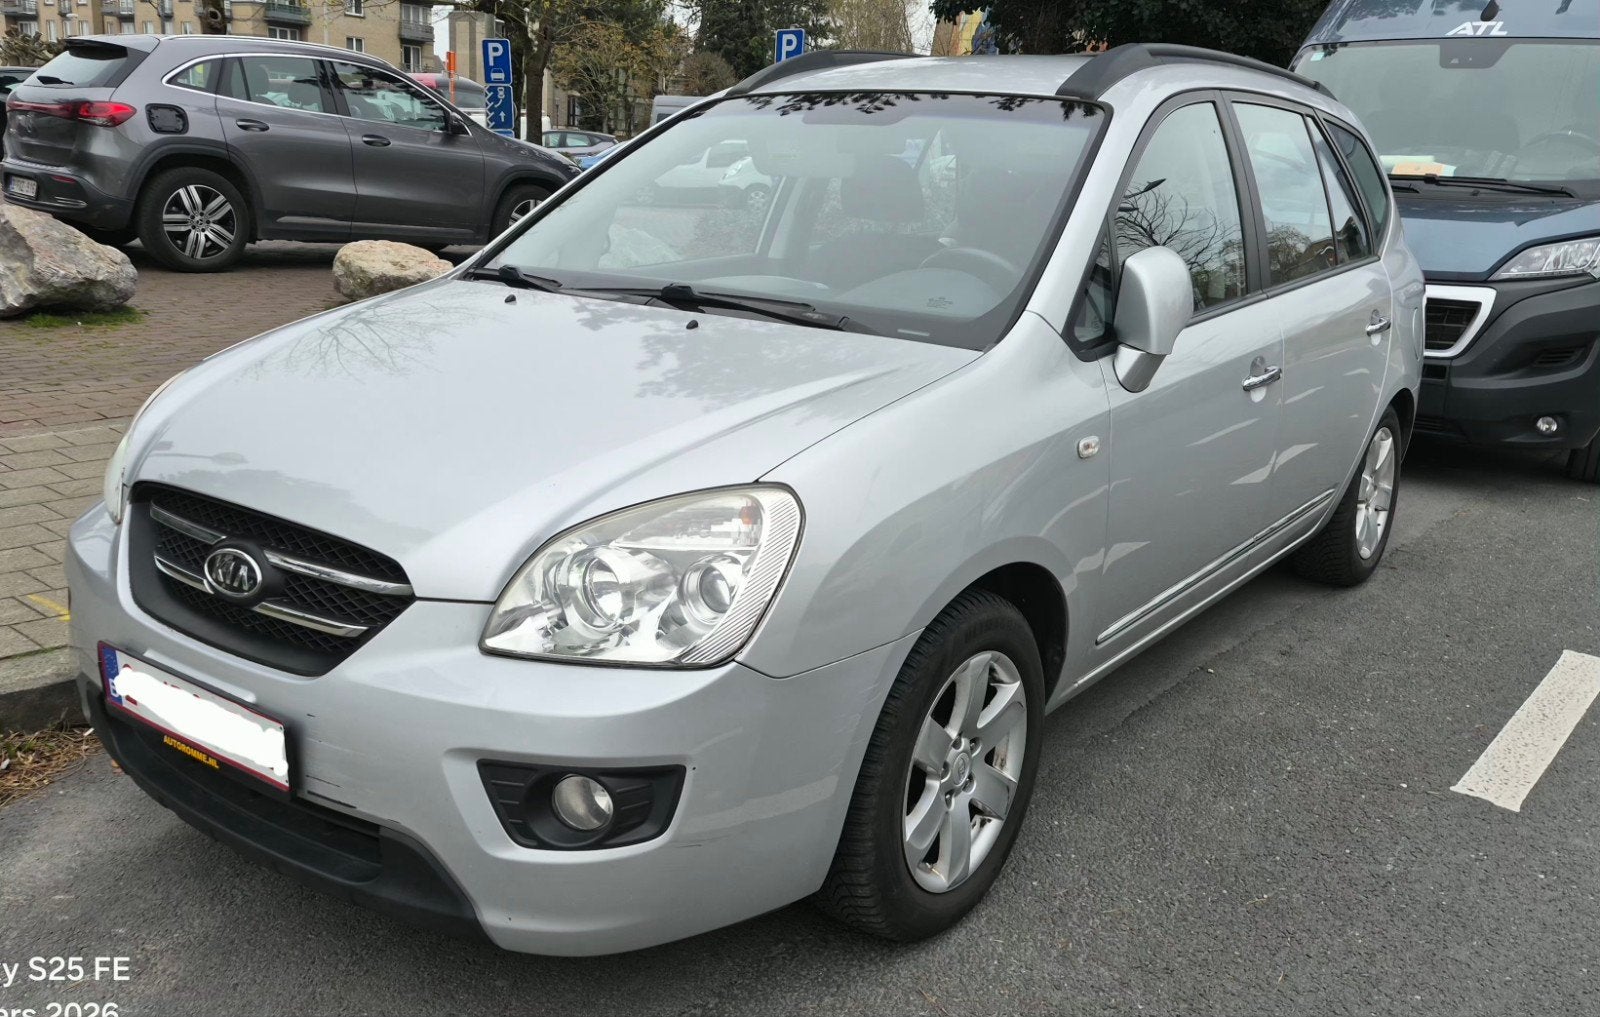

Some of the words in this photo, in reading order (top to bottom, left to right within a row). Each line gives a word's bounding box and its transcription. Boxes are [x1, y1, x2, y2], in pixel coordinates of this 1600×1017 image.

[1444, 21, 1508, 36] ATL
[487, 42, 503, 66] P
[781, 34, 797, 61] P
